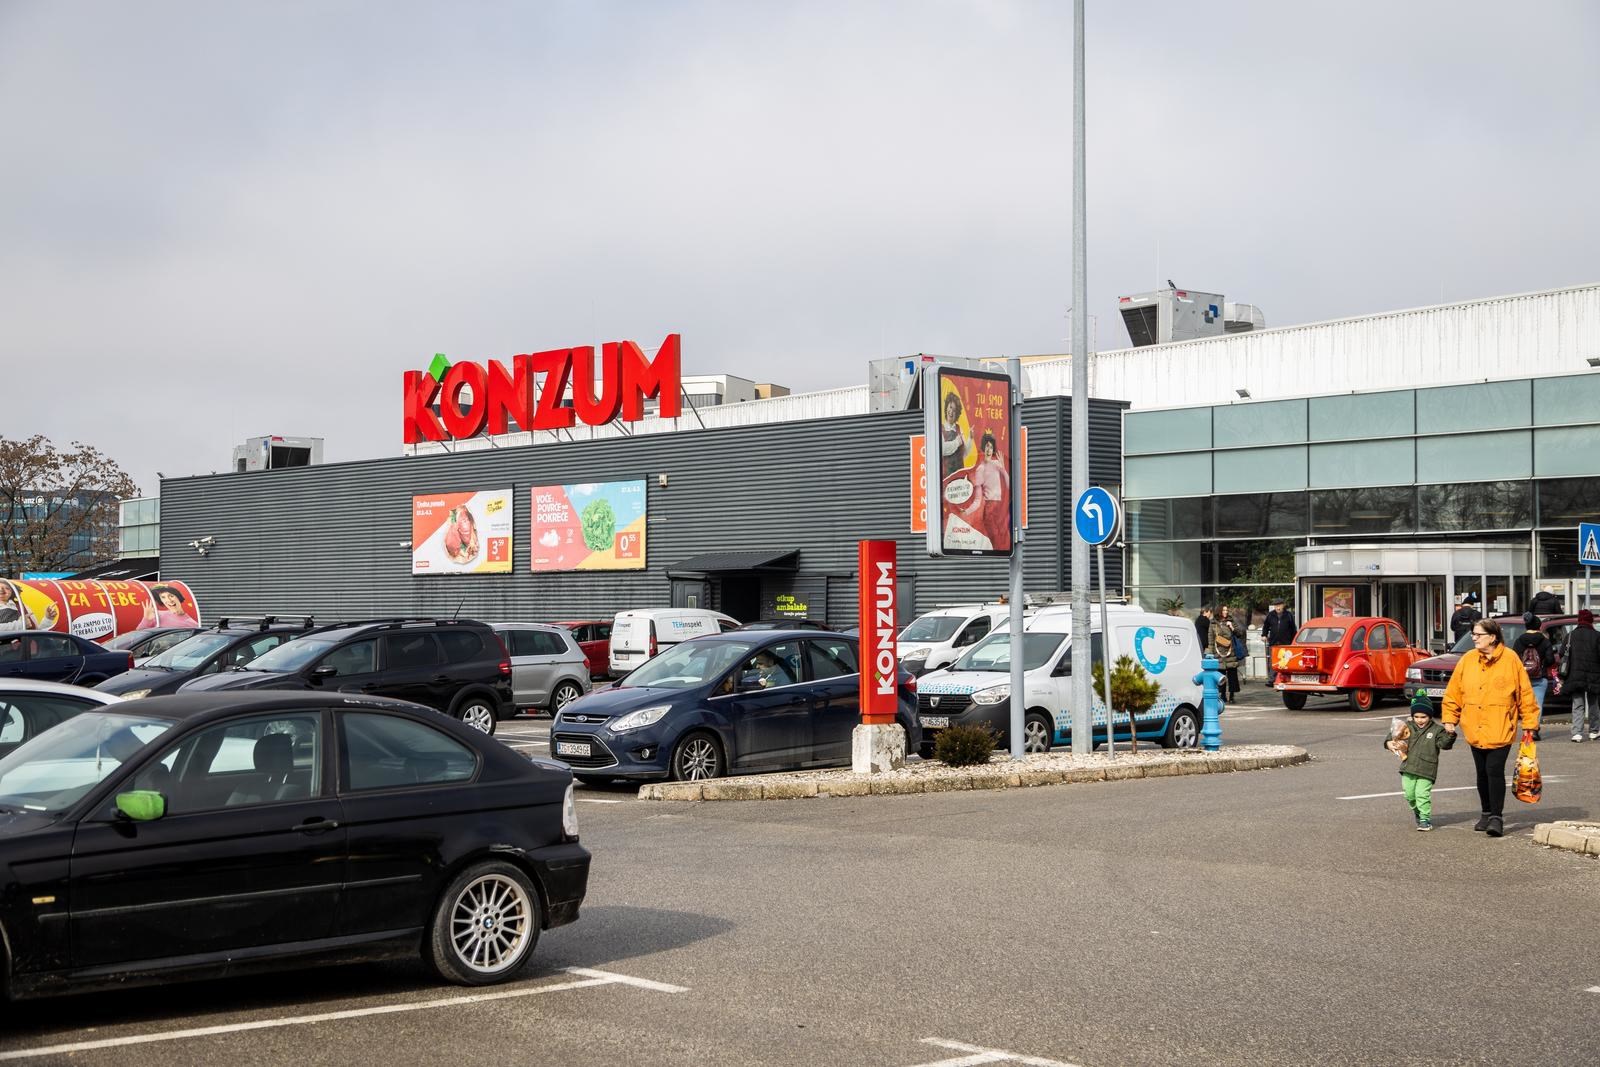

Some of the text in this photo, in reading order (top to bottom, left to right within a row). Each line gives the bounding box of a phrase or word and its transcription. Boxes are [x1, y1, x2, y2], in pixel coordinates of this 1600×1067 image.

[403, 333, 682, 444] KONZUM
[976, 393, 1003, 406] TU SMO
[975, 407, 1003, 419] ZA TEBE
[64, 582, 87, 590] TU
[67, 592, 140, 608] ZA TEBE
[776, 603, 807, 611] ambalaže
[672, 621, 703, 629] TEHinspekt
[875, 561, 895, 695] KONZUM
